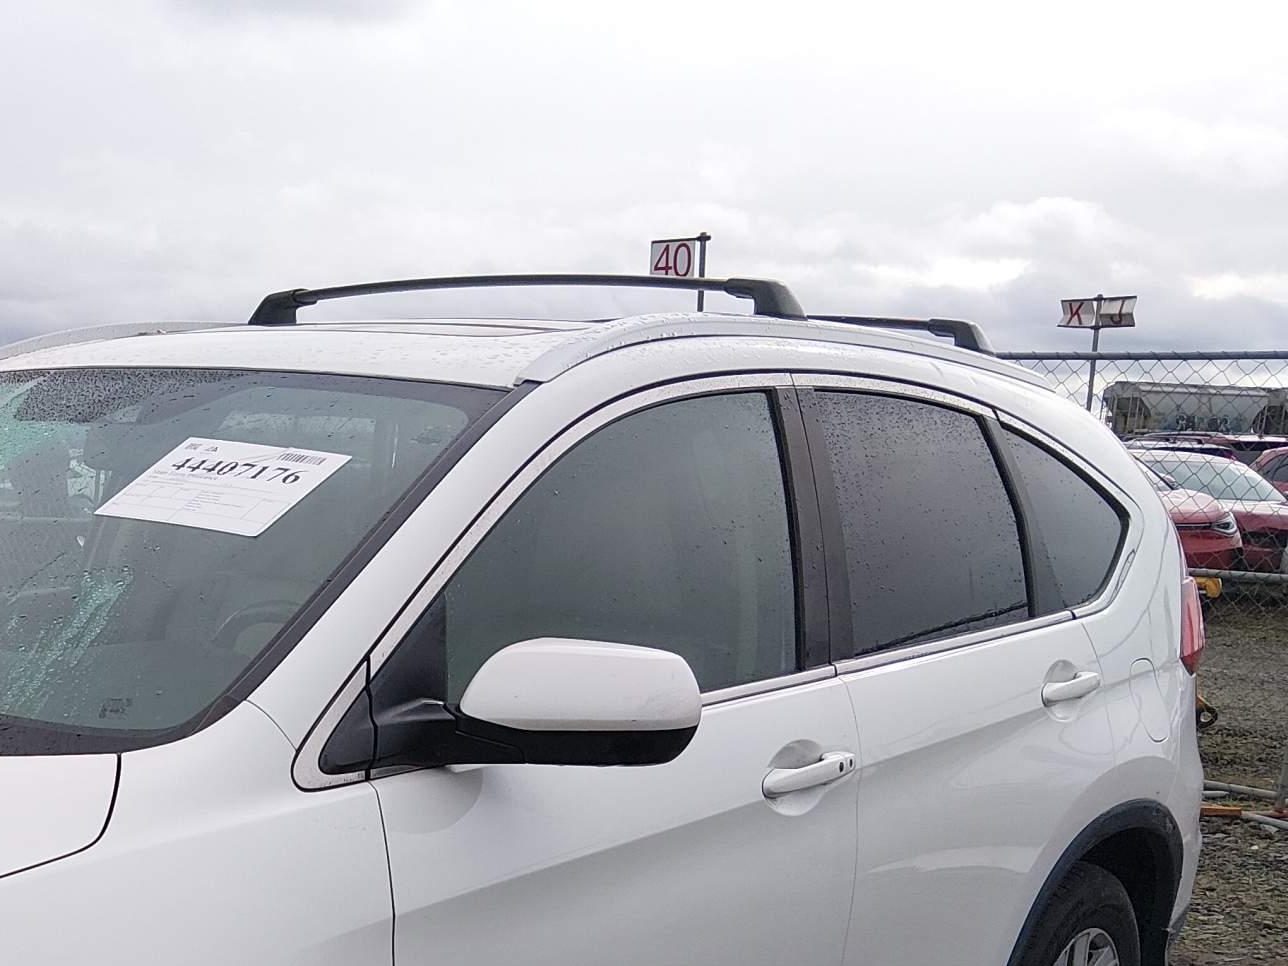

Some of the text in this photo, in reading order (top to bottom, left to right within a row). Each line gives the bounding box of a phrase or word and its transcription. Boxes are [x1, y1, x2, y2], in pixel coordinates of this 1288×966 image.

[653, 242, 692, 277] 40
[1066, 301, 1085, 326] K
[1110, 300, 1126, 325] J
[171, 456, 309, 485] 44407176
